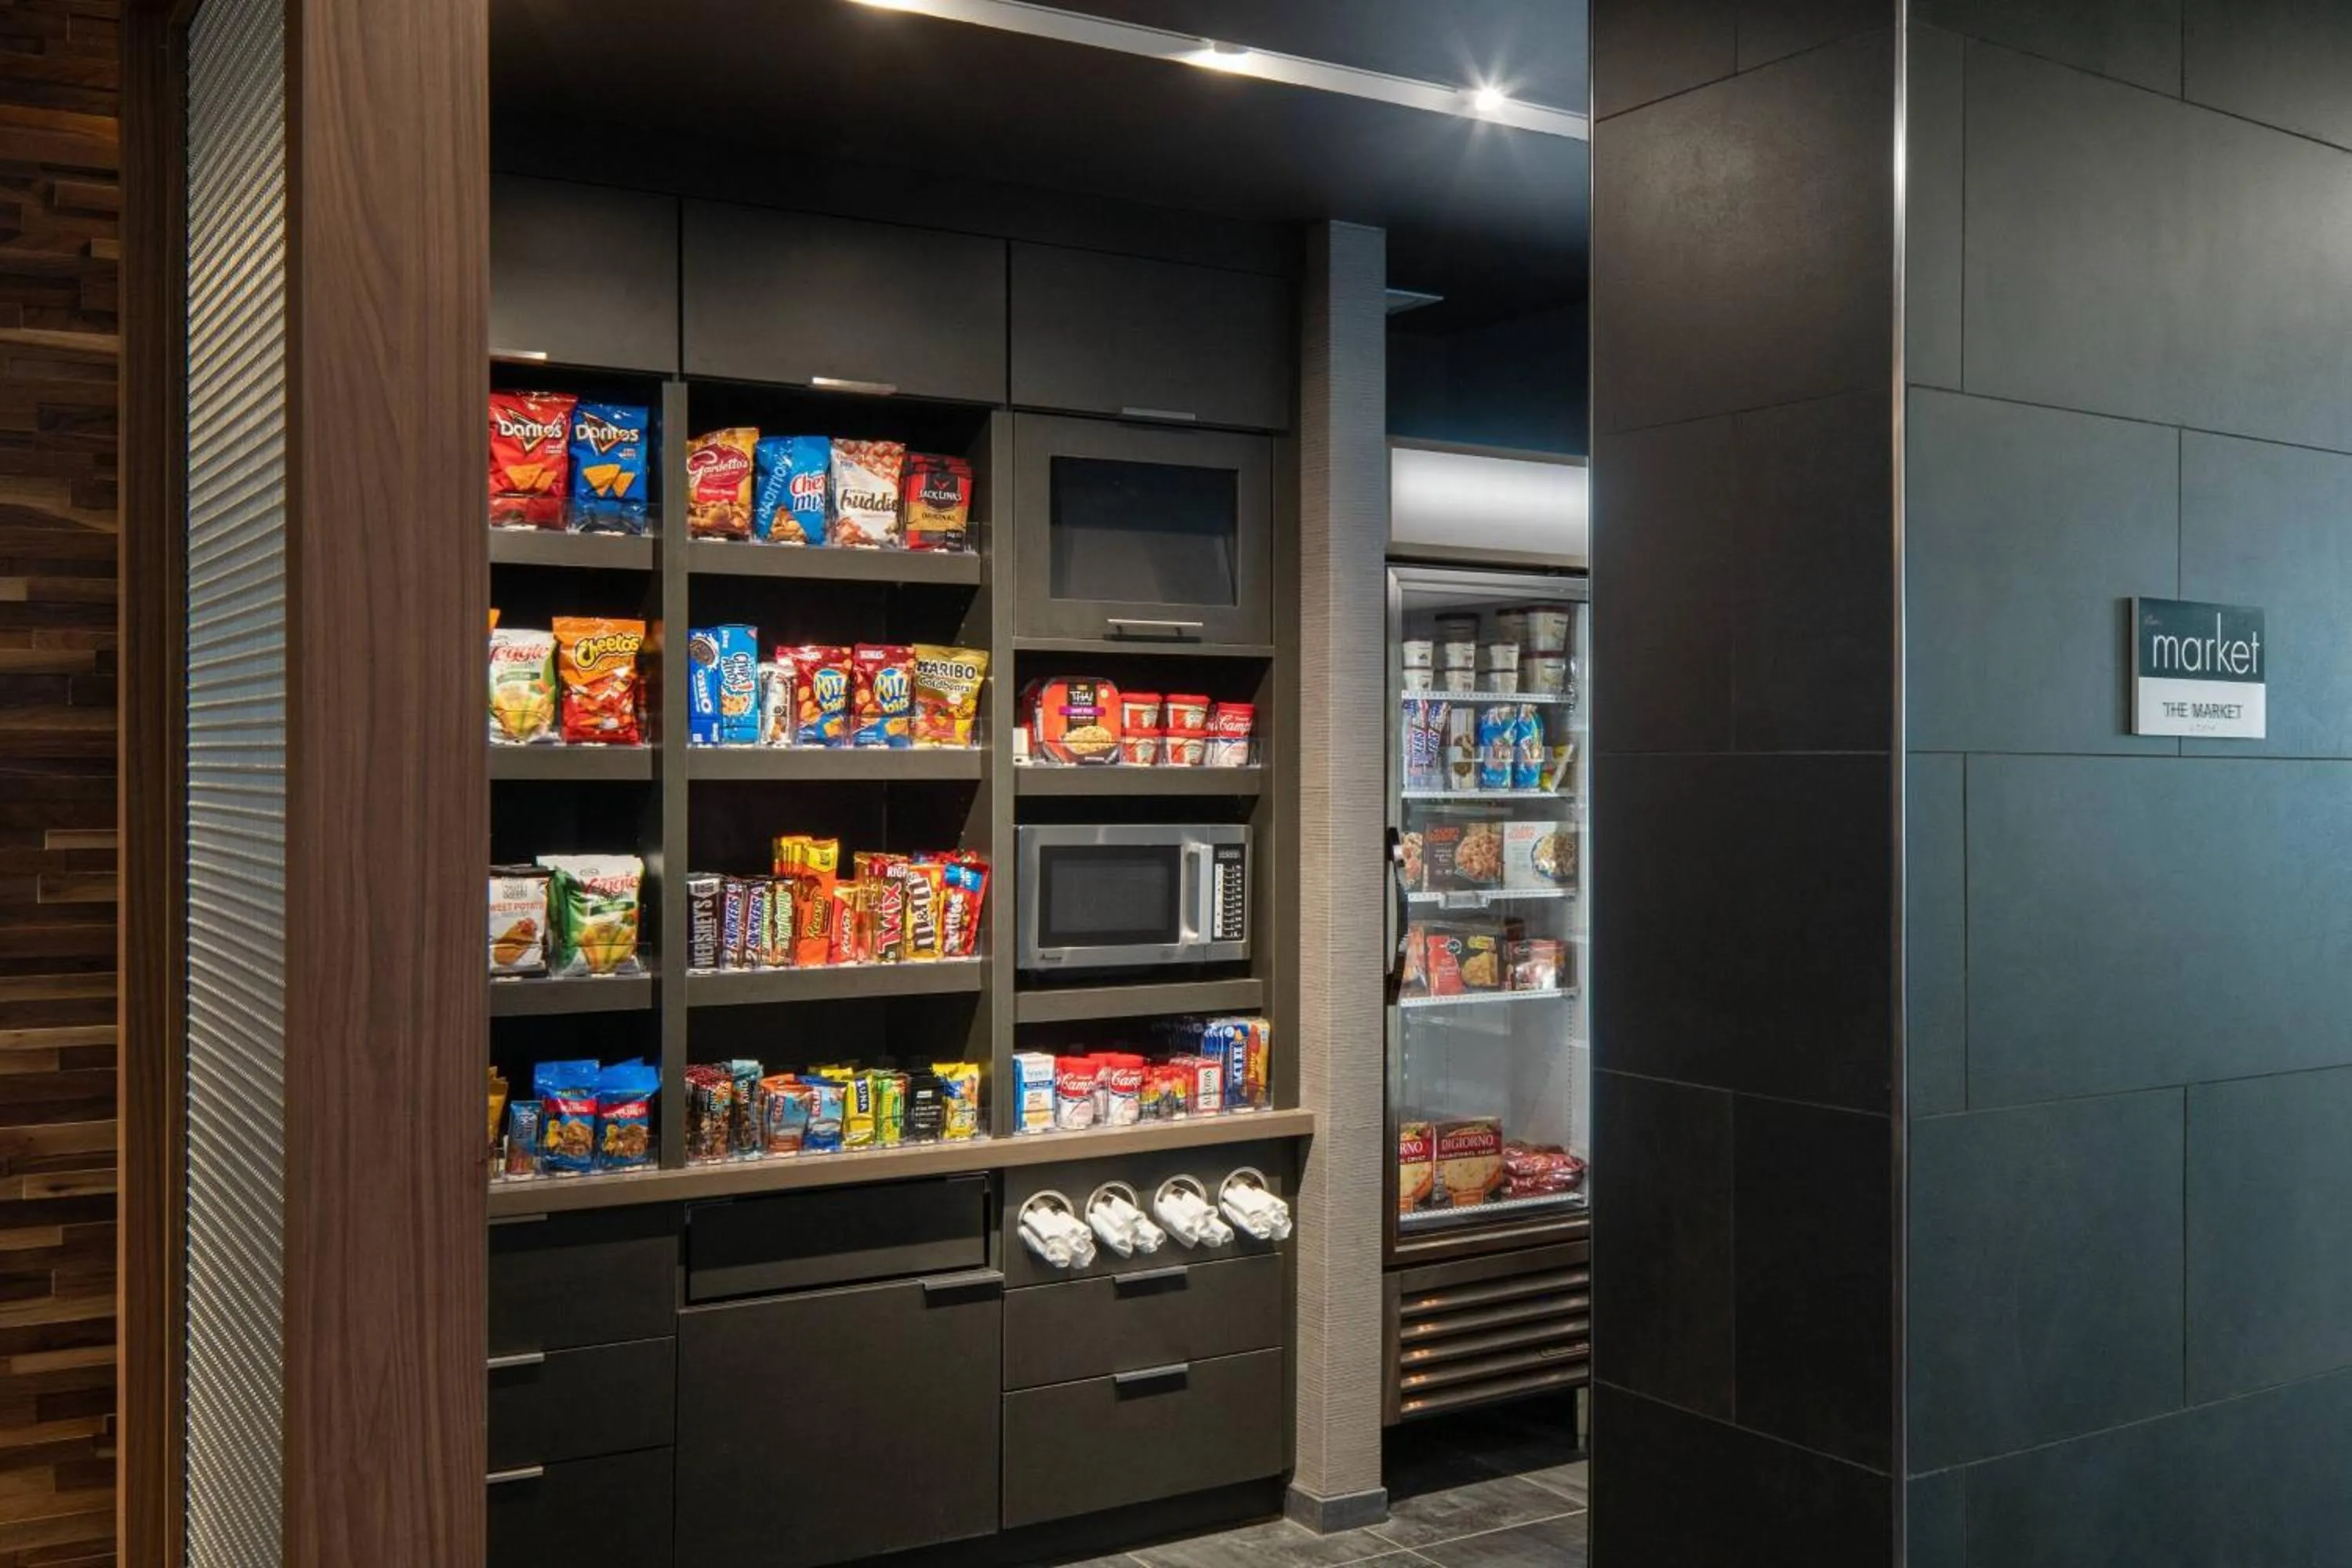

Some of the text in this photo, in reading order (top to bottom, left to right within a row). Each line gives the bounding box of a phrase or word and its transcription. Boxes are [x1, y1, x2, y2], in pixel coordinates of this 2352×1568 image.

[500, 419, 562, 439] Doritos
[575, 422, 640, 442] Doritos
[575, 633, 640, 666] Cheetos
[2153, 612, 2260, 674] market
[916, 661, 976, 681] HARIBO
[696, 669, 713, 713] OREO
[2162, 702, 2244, 720] THE MARKET
[693, 899, 715, 966] HERSHEY'S
[725, 896, 740, 947] SNICKERS
[943, 893, 964, 953] Skittles
[856, 1080, 868, 1112] LUNA
